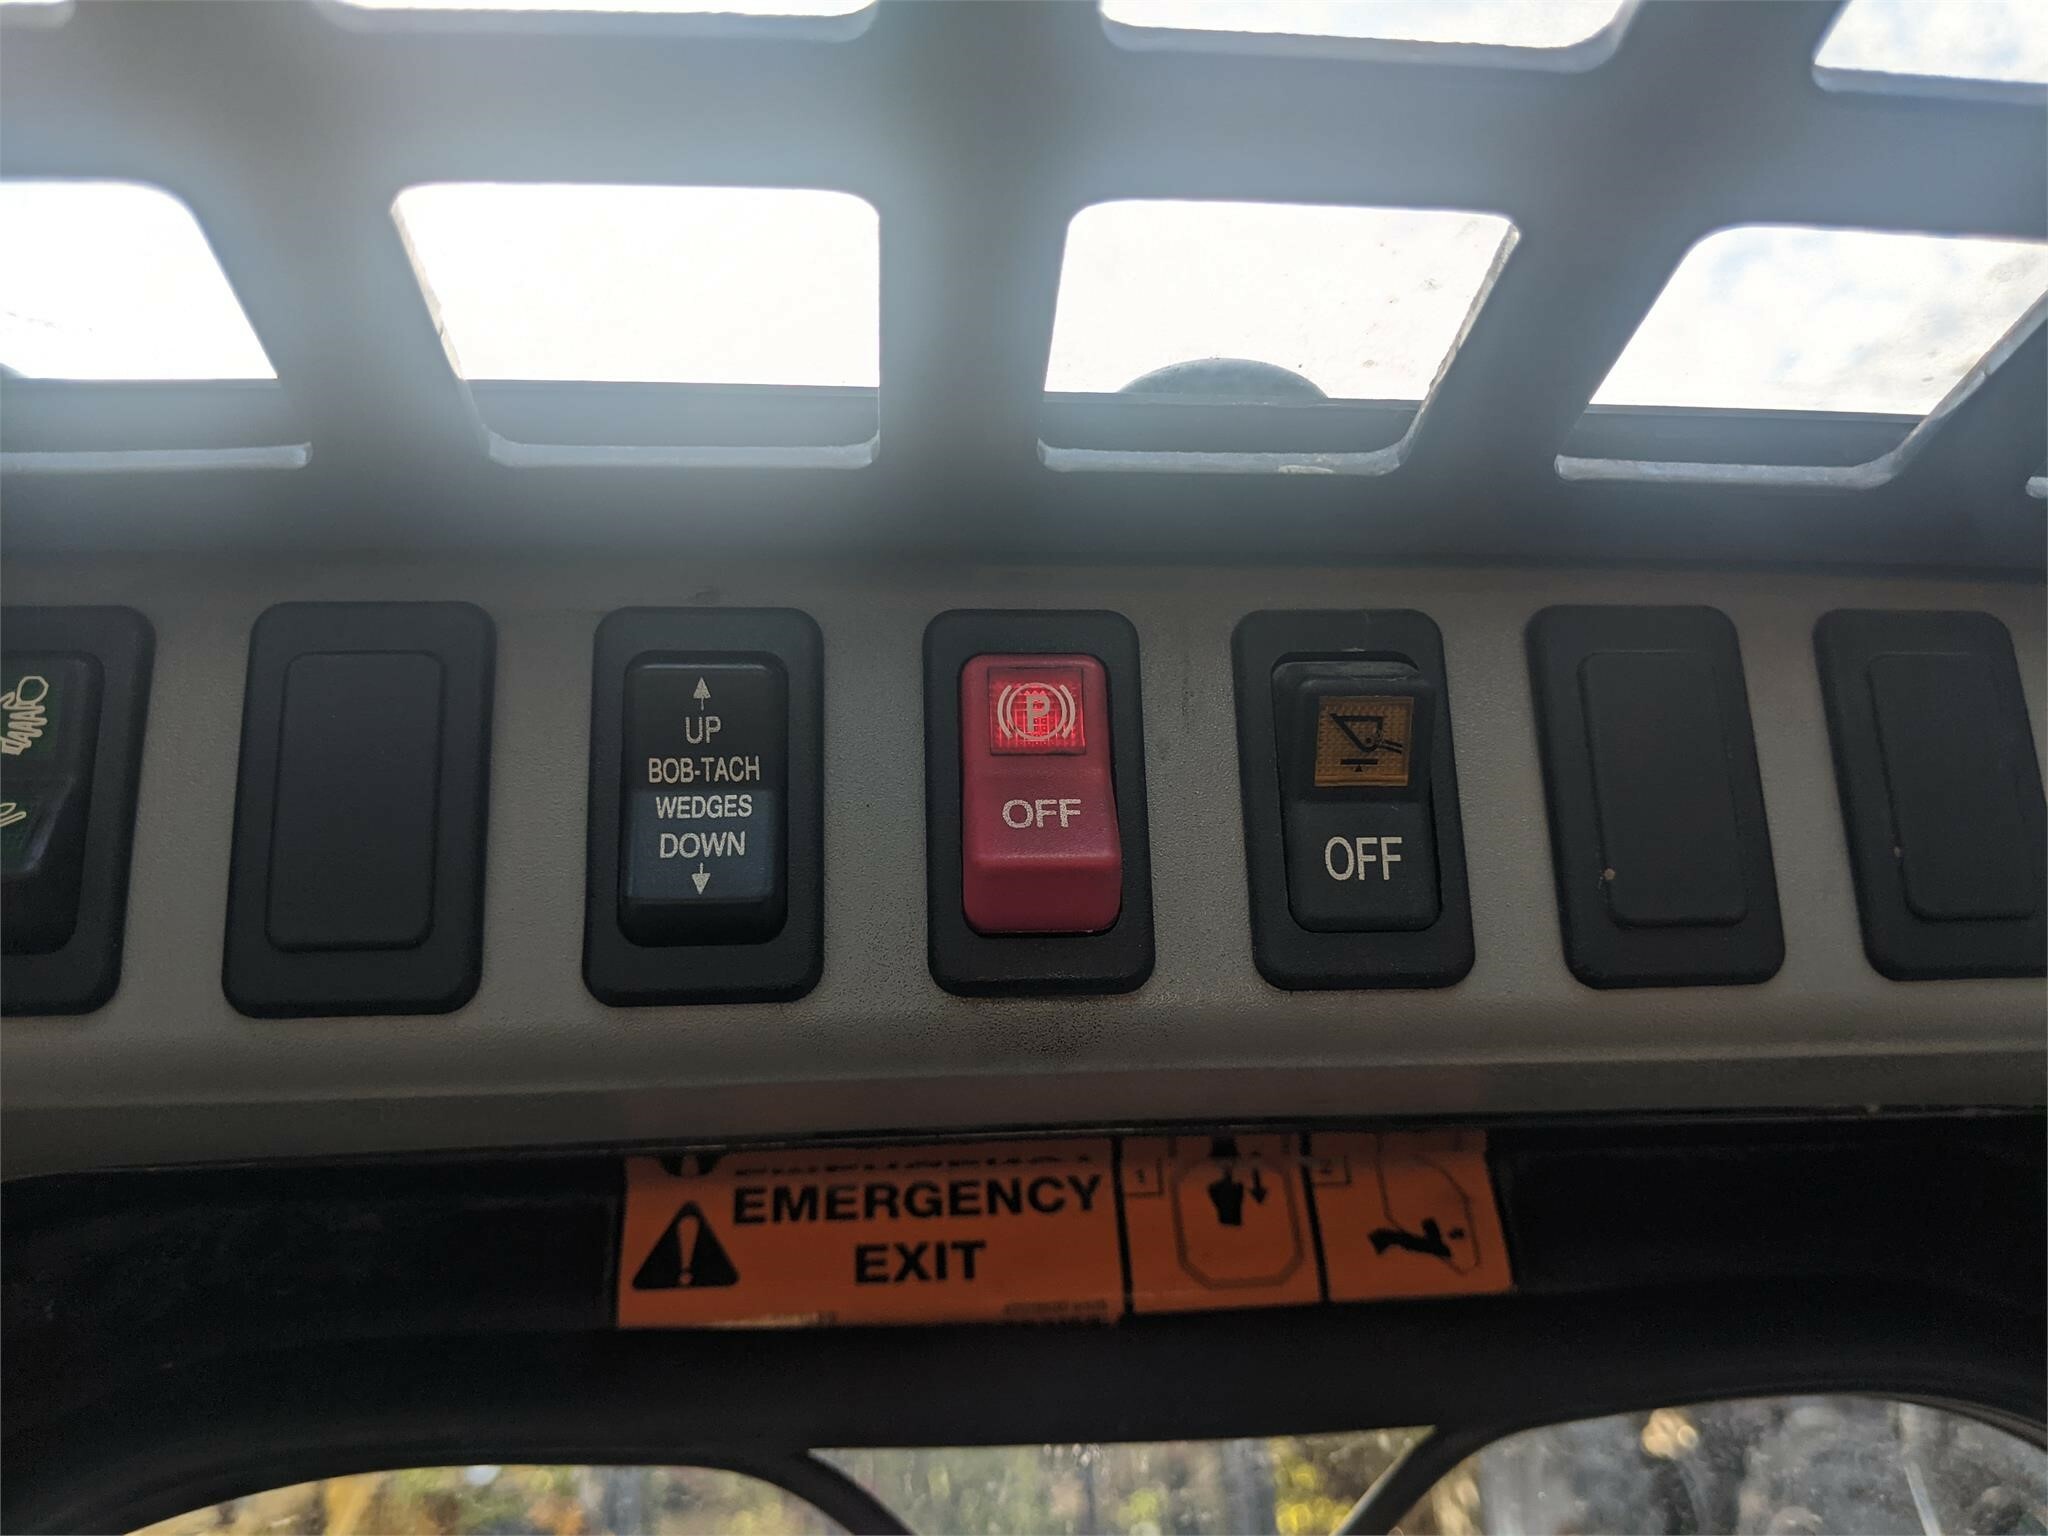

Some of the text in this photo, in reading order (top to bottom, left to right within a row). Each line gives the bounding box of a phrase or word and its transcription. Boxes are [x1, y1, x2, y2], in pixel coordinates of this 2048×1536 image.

[1024, 693, 1051, 733] P
[684, 715, 722, 744] UP
[648, 755, 761, 784] BOB-TACH
[655, 794, 753, 819] WEDGES
[1001, 798, 1082, 829] OFF
[659, 831, 746, 859] DOWN
[1324, 836, 1403, 882] OFF
[732, 1174, 1101, 1226] EMERGENCY
[853, 1239, 987, 1285] EXIT
